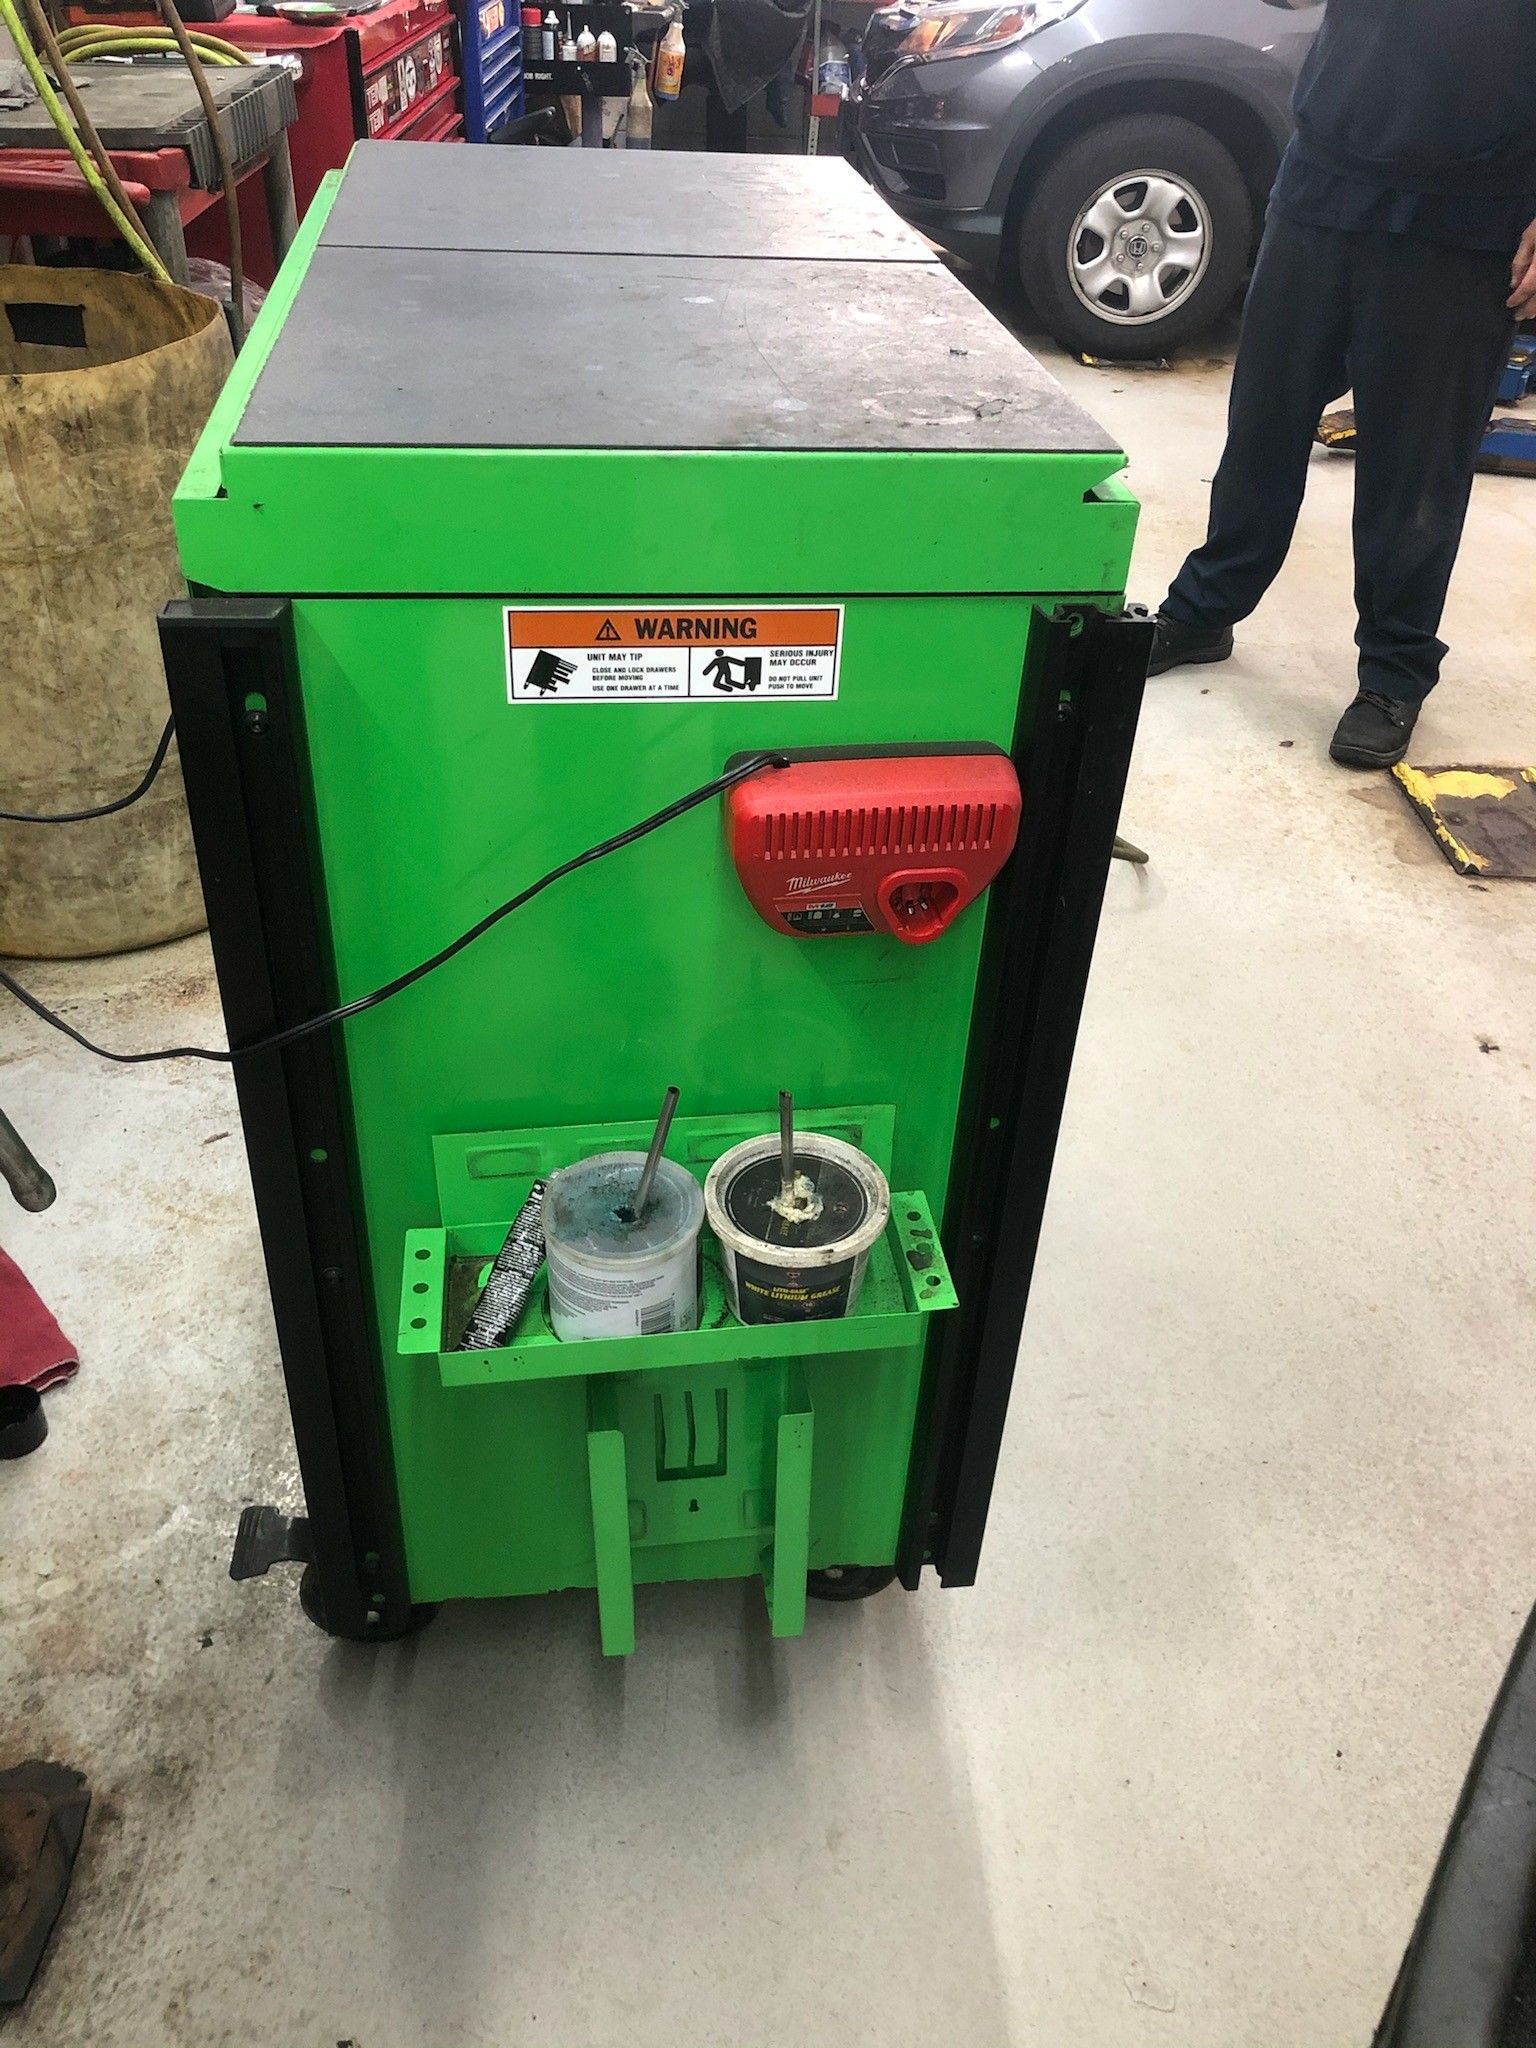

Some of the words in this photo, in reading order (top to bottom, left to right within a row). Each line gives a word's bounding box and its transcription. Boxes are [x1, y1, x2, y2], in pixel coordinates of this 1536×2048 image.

[634, 617, 757, 640] WARNING
[587, 653, 605, 661] UNIT
[608, 653, 627, 661] MAY
[630, 653, 643, 661] TIP
[806, 649, 834, 657] INJURY
[786, 872, 852, 891] Milwaukee
[744, 1280, 770, 1296] WHITE
[771, 1291, 808, 1300] LITHIUM
[810, 1285, 841, 1300] GREASE
